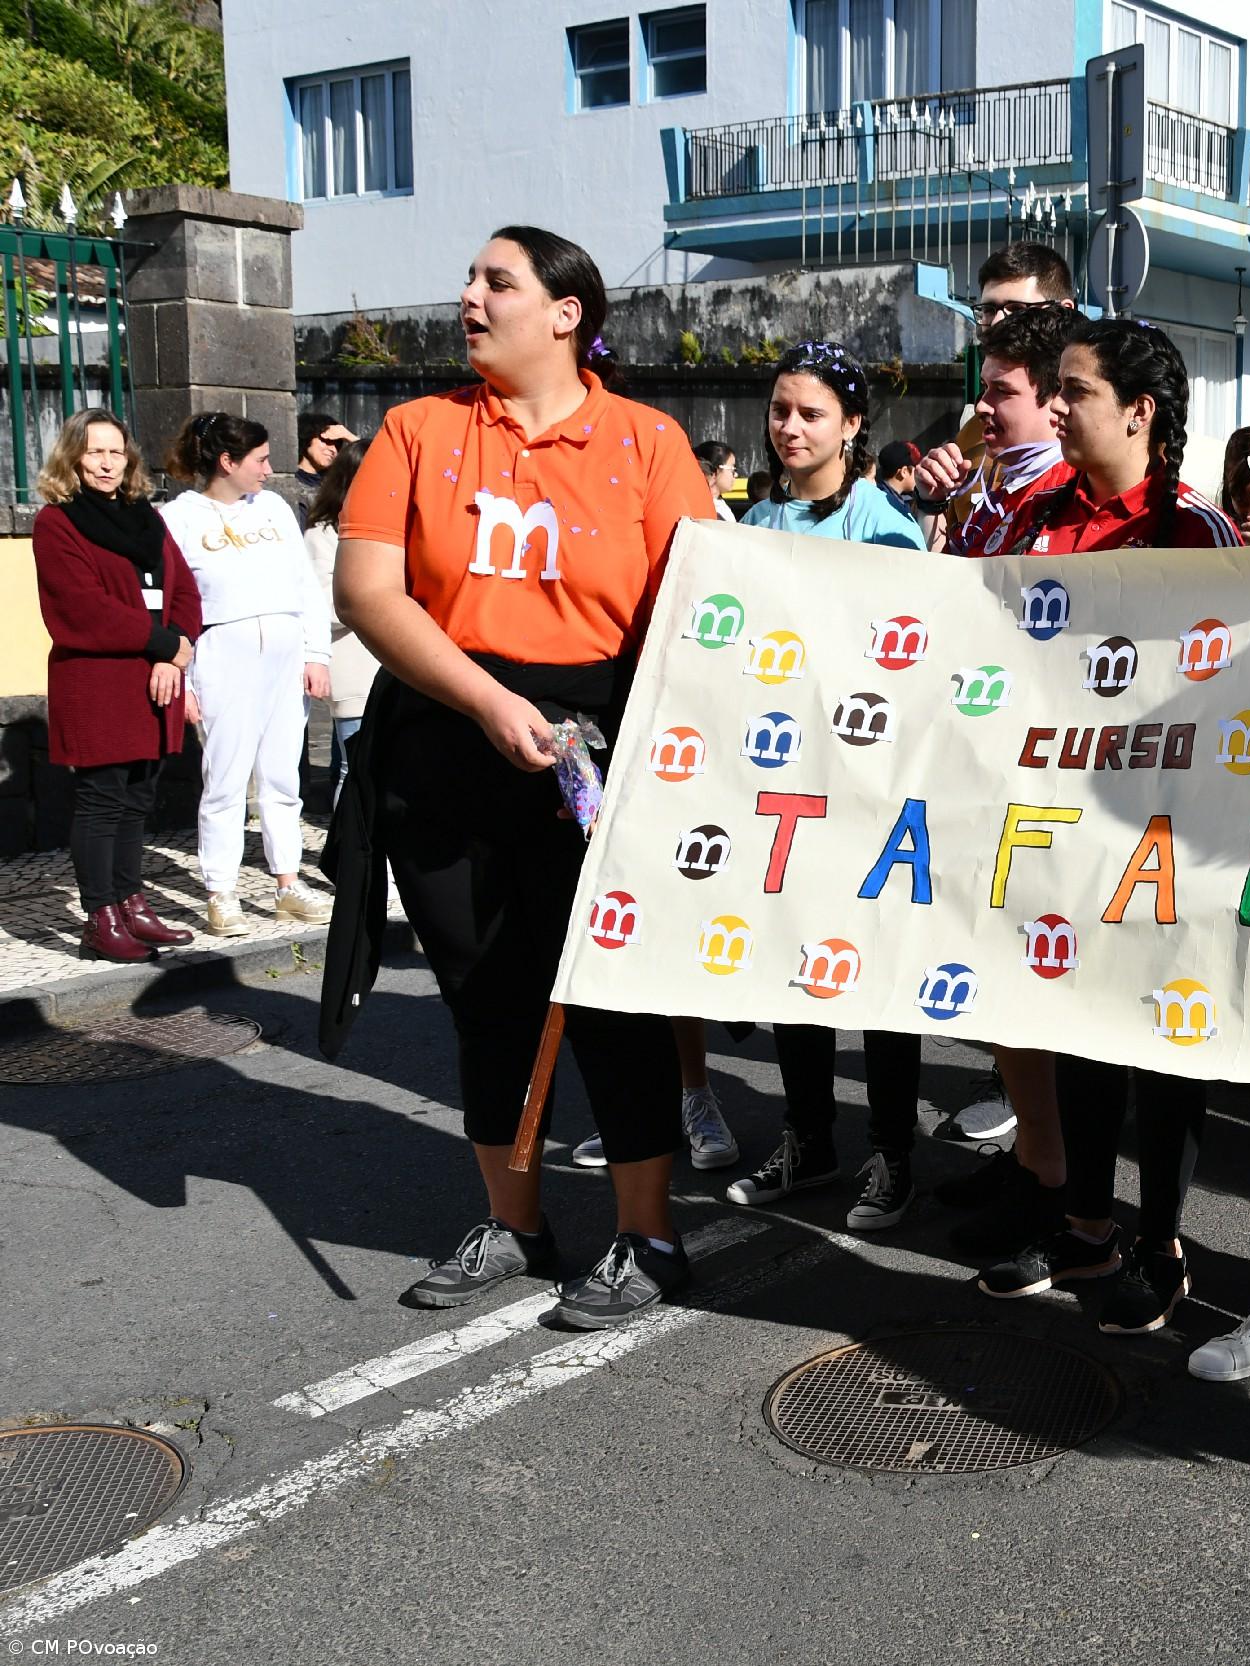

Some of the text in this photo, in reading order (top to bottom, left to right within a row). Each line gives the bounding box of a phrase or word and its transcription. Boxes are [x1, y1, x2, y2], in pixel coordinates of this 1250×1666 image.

[468, 492, 561, 580] m
[684, 598, 741, 645] m
[1018, 587, 1070, 630] m
[743, 637, 804, 679] m
[866, 621, 927, 661] m
[1177, 627, 1231, 672] m
[952, 668, 1012, 707] m
[1084, 644, 1138, 689] m
[740, 718, 801, 762] m
[831, 698, 895, 742] m
[647, 733, 705, 774] m
[1018, 723, 1197, 770] CURSO
[671, 830, 731, 873] m
[586, 893, 642, 945] m
[695, 919, 753, 970] m
[1022, 921, 1080, 968] m
[795, 944, 860, 992] m
[914, 967, 978, 1013] m
[1153, 989, 1217, 1037] m
